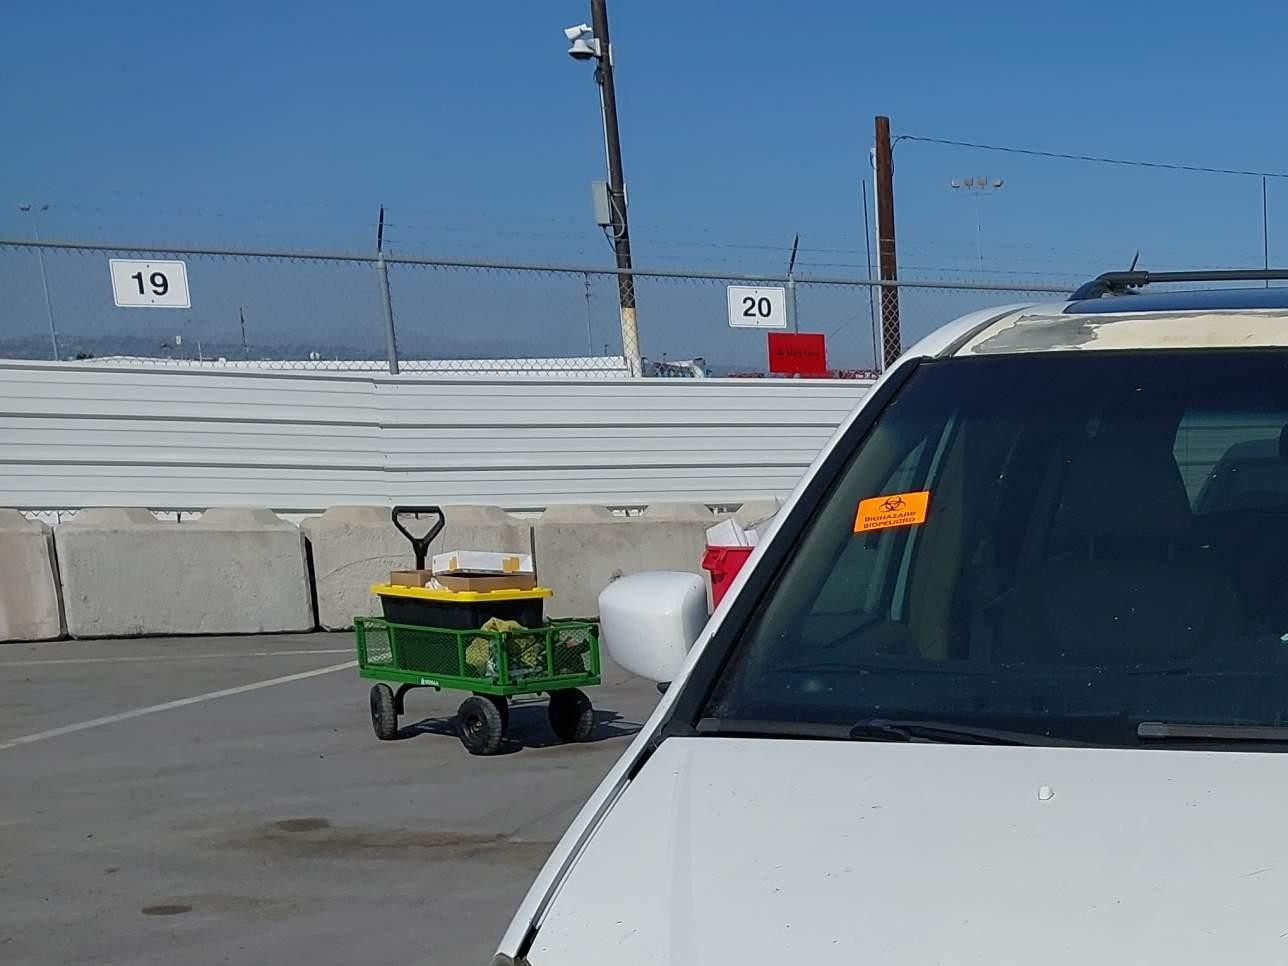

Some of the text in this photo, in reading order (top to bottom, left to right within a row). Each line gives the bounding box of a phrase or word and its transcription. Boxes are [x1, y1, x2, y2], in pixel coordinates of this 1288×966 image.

[131, 271, 169, 296] 19
[742, 296, 772, 318] 20
[864, 511, 917, 522] BIOHAZARD
